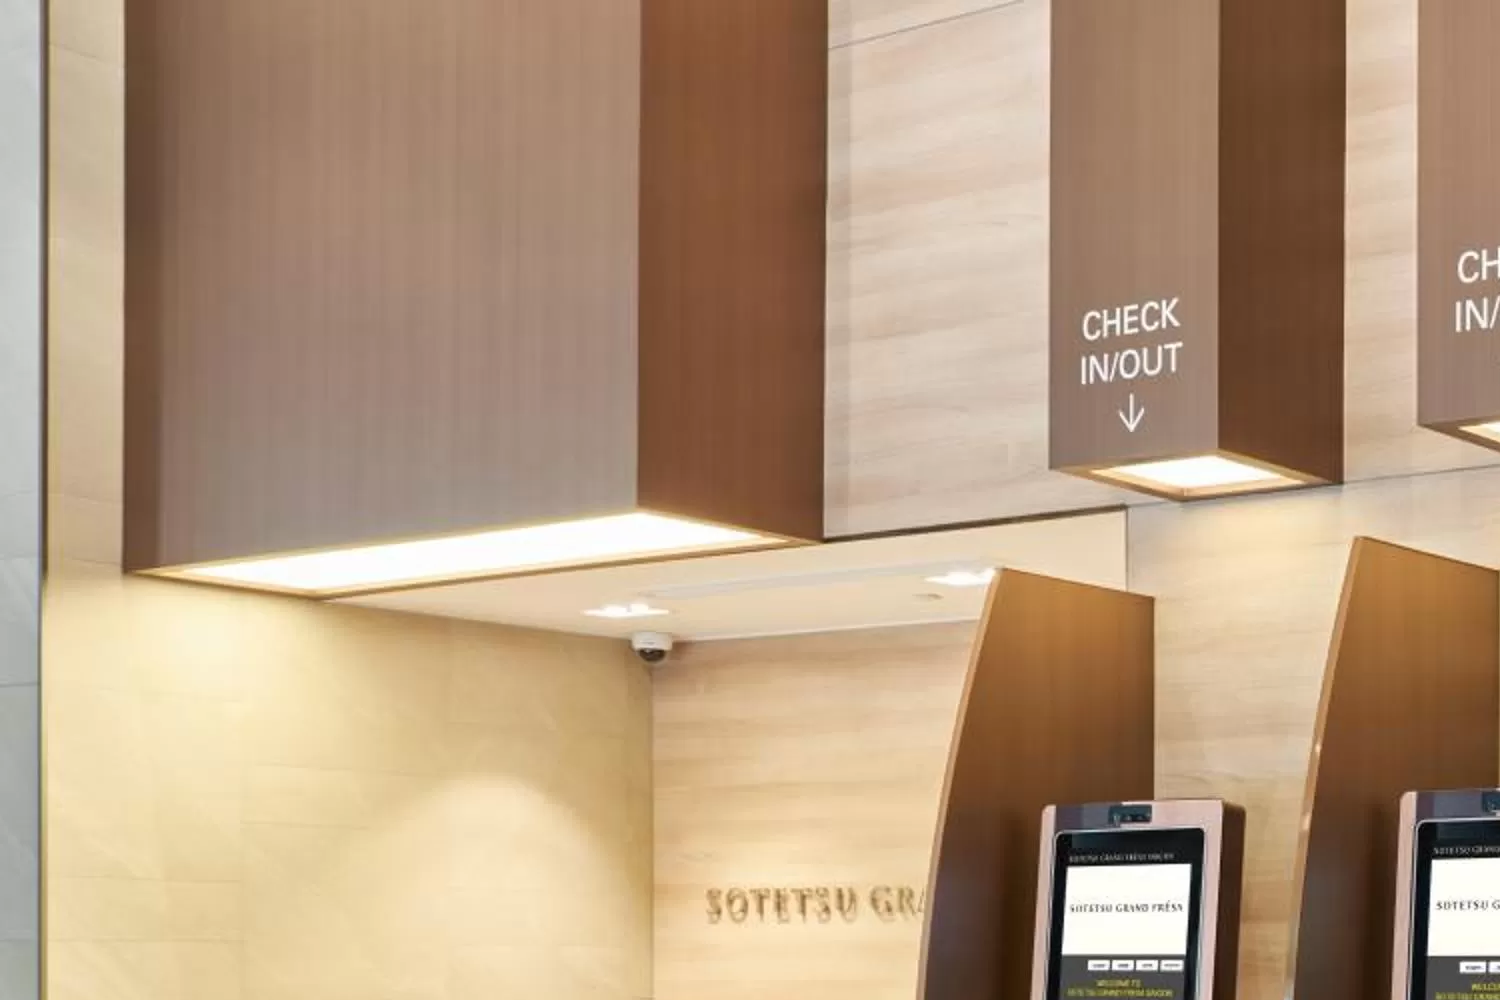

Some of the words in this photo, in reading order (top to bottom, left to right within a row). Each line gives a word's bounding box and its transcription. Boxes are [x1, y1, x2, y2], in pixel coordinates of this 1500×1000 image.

[1083, 297, 1181, 341] CHECK
[1081, 341, 1183, 385] IN/OUT
[706, 887, 858, 920] SOTETSU
[1435, 901, 1489, 911] SOTETSU
